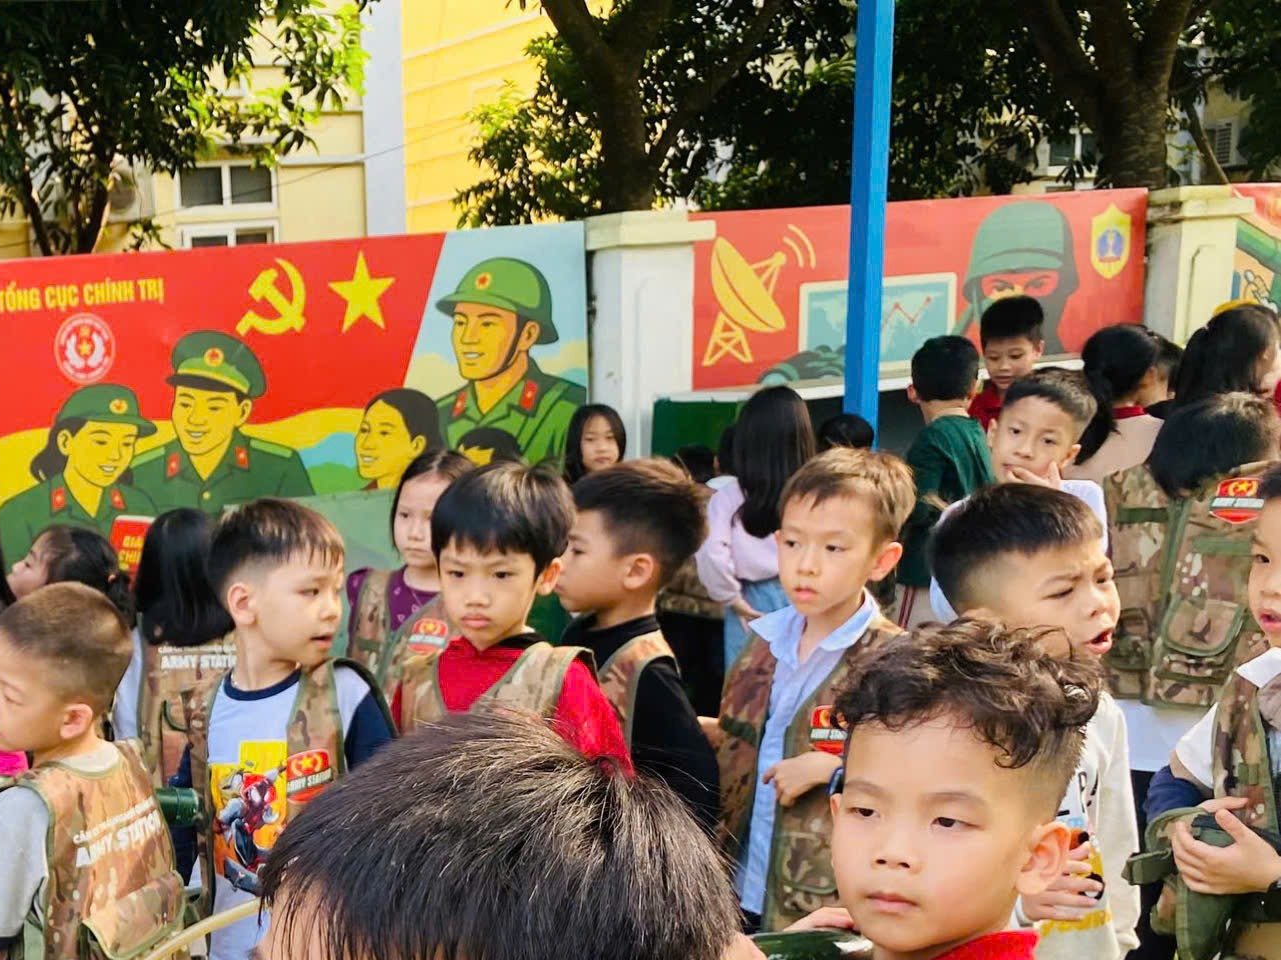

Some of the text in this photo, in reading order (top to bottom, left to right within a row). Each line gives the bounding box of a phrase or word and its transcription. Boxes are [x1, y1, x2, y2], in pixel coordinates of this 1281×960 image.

[45, 284, 79, 311] CỤC
[83, 277, 134, 305] CHÍNH
[137, 278, 164, 304] TRỊ
